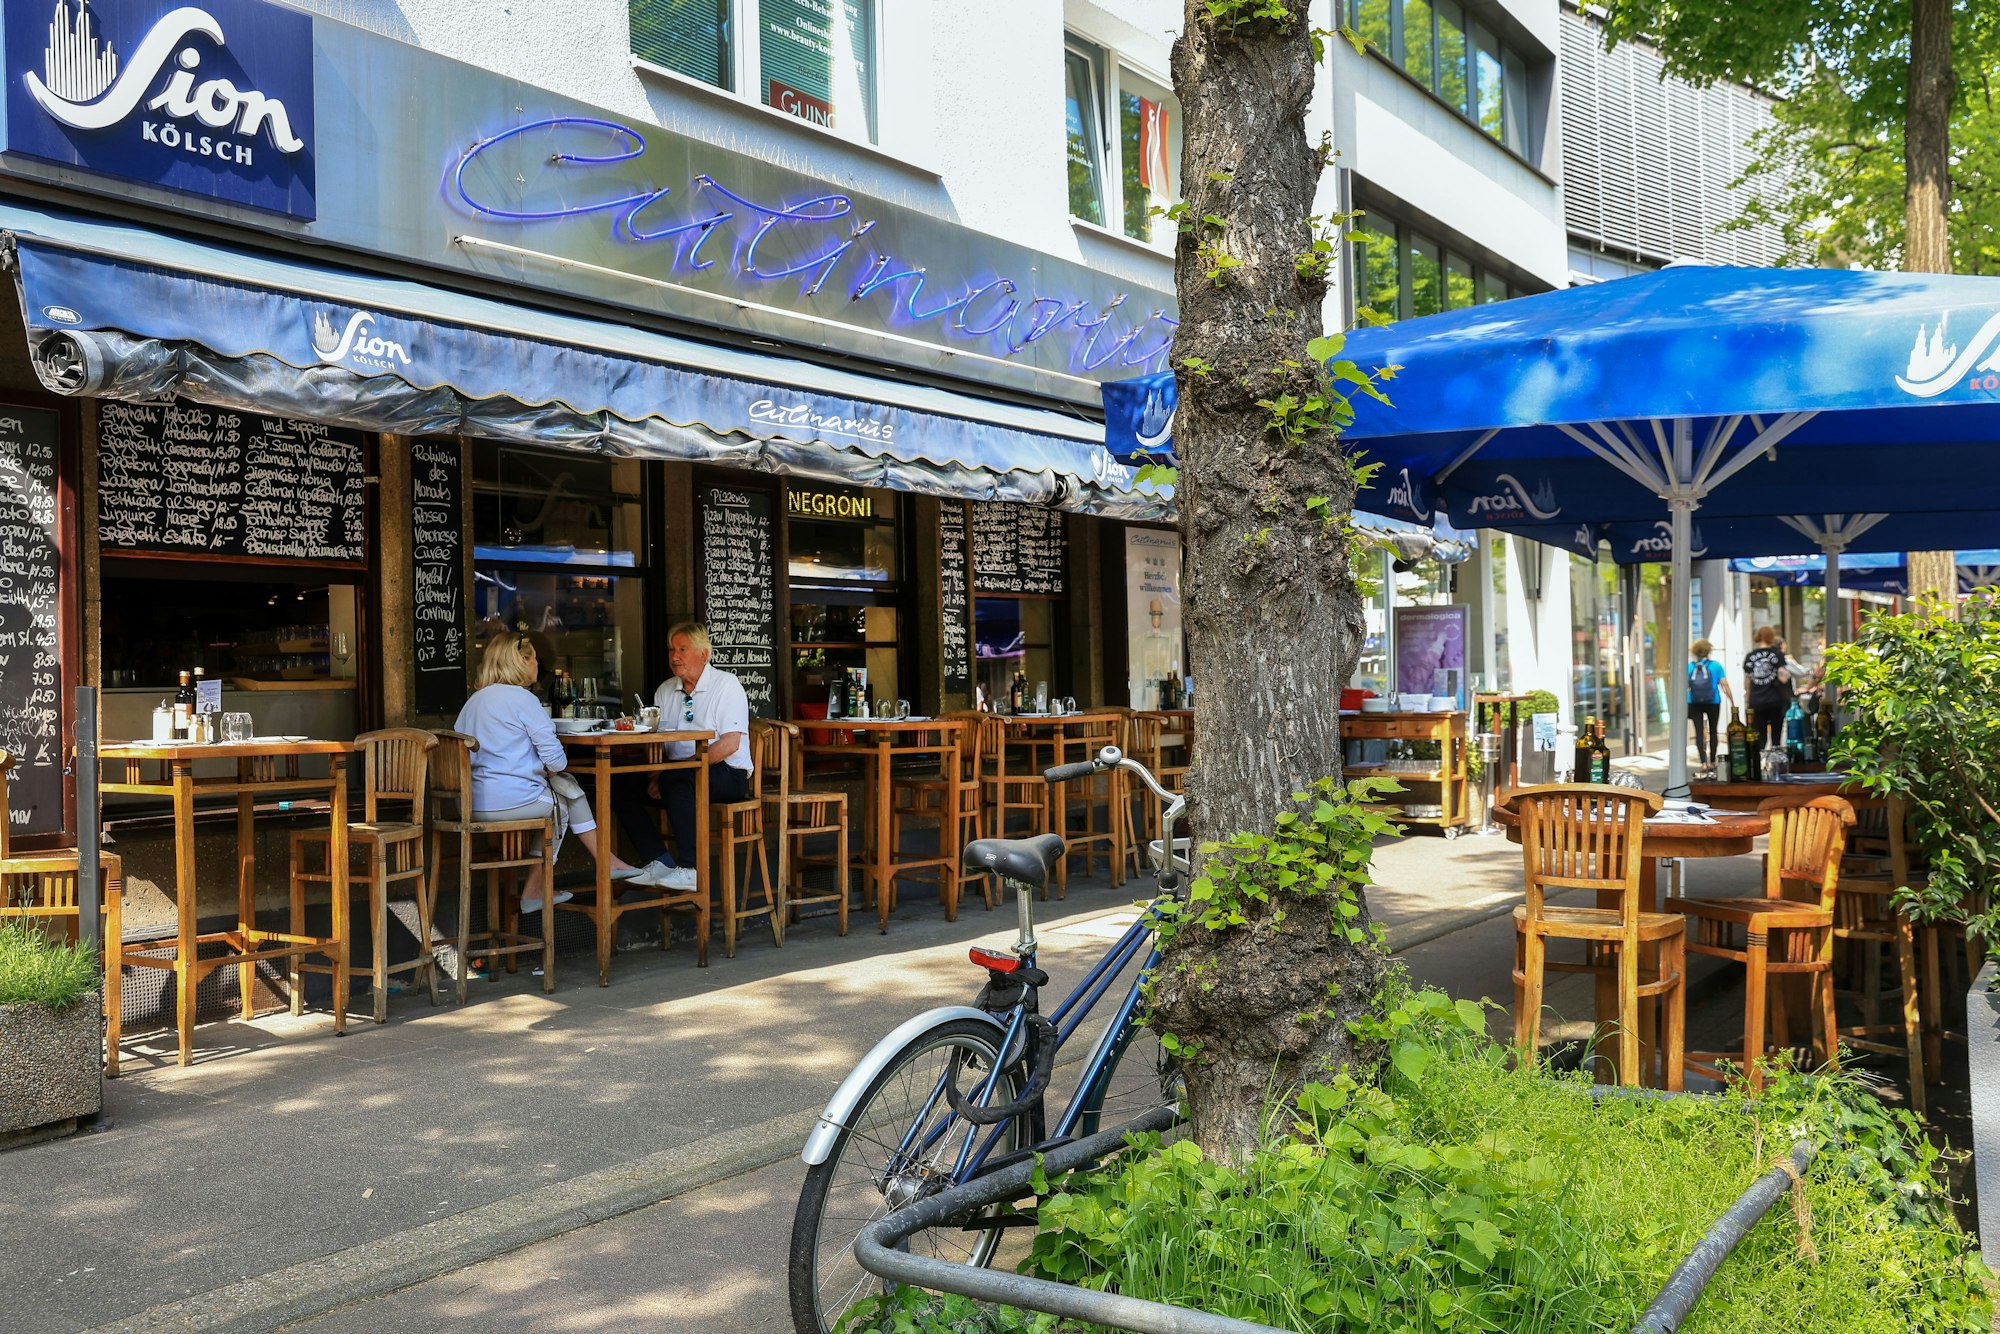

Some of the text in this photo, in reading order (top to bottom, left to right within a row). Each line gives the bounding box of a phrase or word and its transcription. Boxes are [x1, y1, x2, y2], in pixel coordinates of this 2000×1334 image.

[26, 6, 304, 154] Sion
[142, 120, 252, 166] KÖLSCH
[455, 116, 1178, 372] Culinariu
[311, 310, 412, 365] Sion
[352, 354, 396, 370] KÖLSCH
[1969, 374, 1999, 390] KÖ
[411, 444, 457, 467] Rotwein
[429, 461, 449, 482] des
[787, 490, 873, 517] NEGRONI
[413, 506, 448, 525] Rosso
[414, 525, 458, 545] Veronese
[415, 604, 456, 624] Corvina
[1400, 612, 1462, 621] dermalogica
